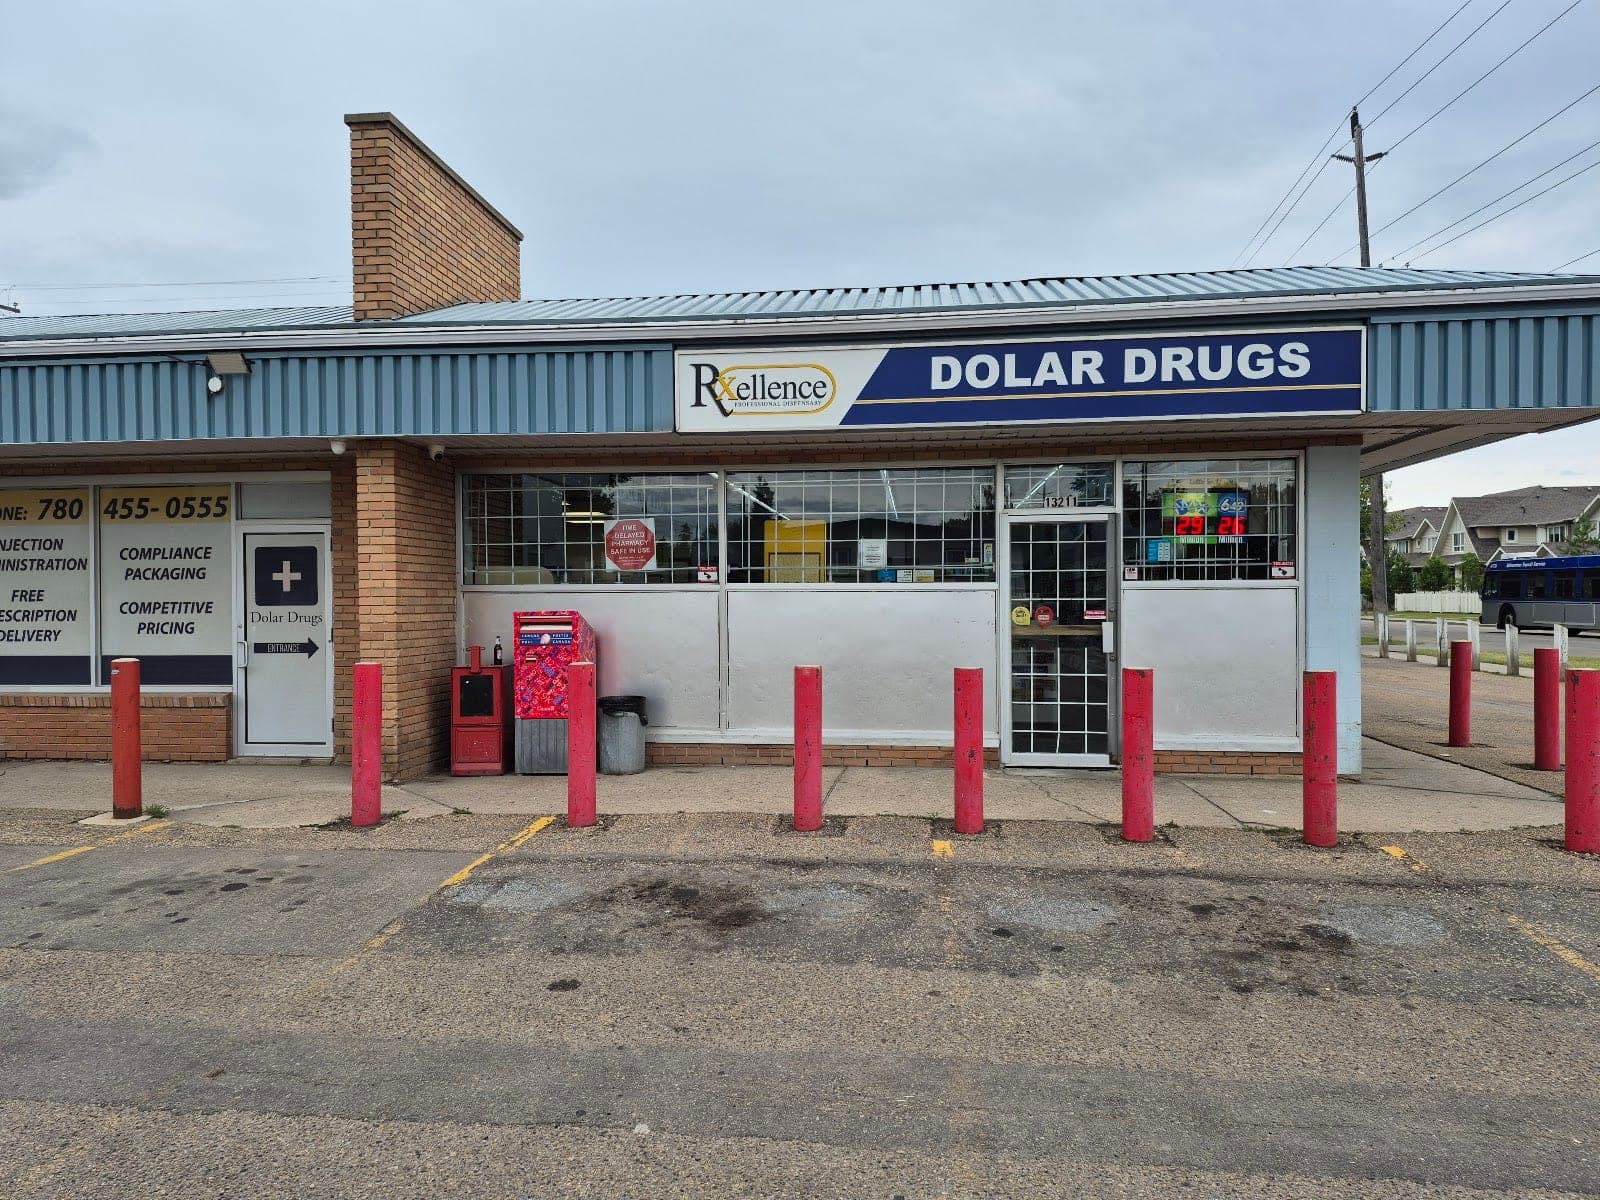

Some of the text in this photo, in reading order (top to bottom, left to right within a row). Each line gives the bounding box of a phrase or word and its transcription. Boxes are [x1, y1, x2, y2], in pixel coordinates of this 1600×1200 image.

[930, 342, 1311, 390] DOLAR DRUGS
[1046, 496, 1077, 508] 13211
[0, 498, 84, 521] NE: 780
[1176, 515, 1205, 536] 29
[614, 531, 645, 539] DELAYED
[611, 539, 649, 547] PHARMACY
[119, 547, 212, 560] COMPLIANCE
[0, 558, 88, 571] INISTRATION
[124, 567, 207, 580] PACKAGING
[11, 590, 45, 602] FREE
[119, 601, 214, 614] COMPETITIVE
[251, 610, 323, 626] Dolar Drugs
[137, 621, 195, 634] PRICING
[267, 643, 300, 653] ENTRANCE
